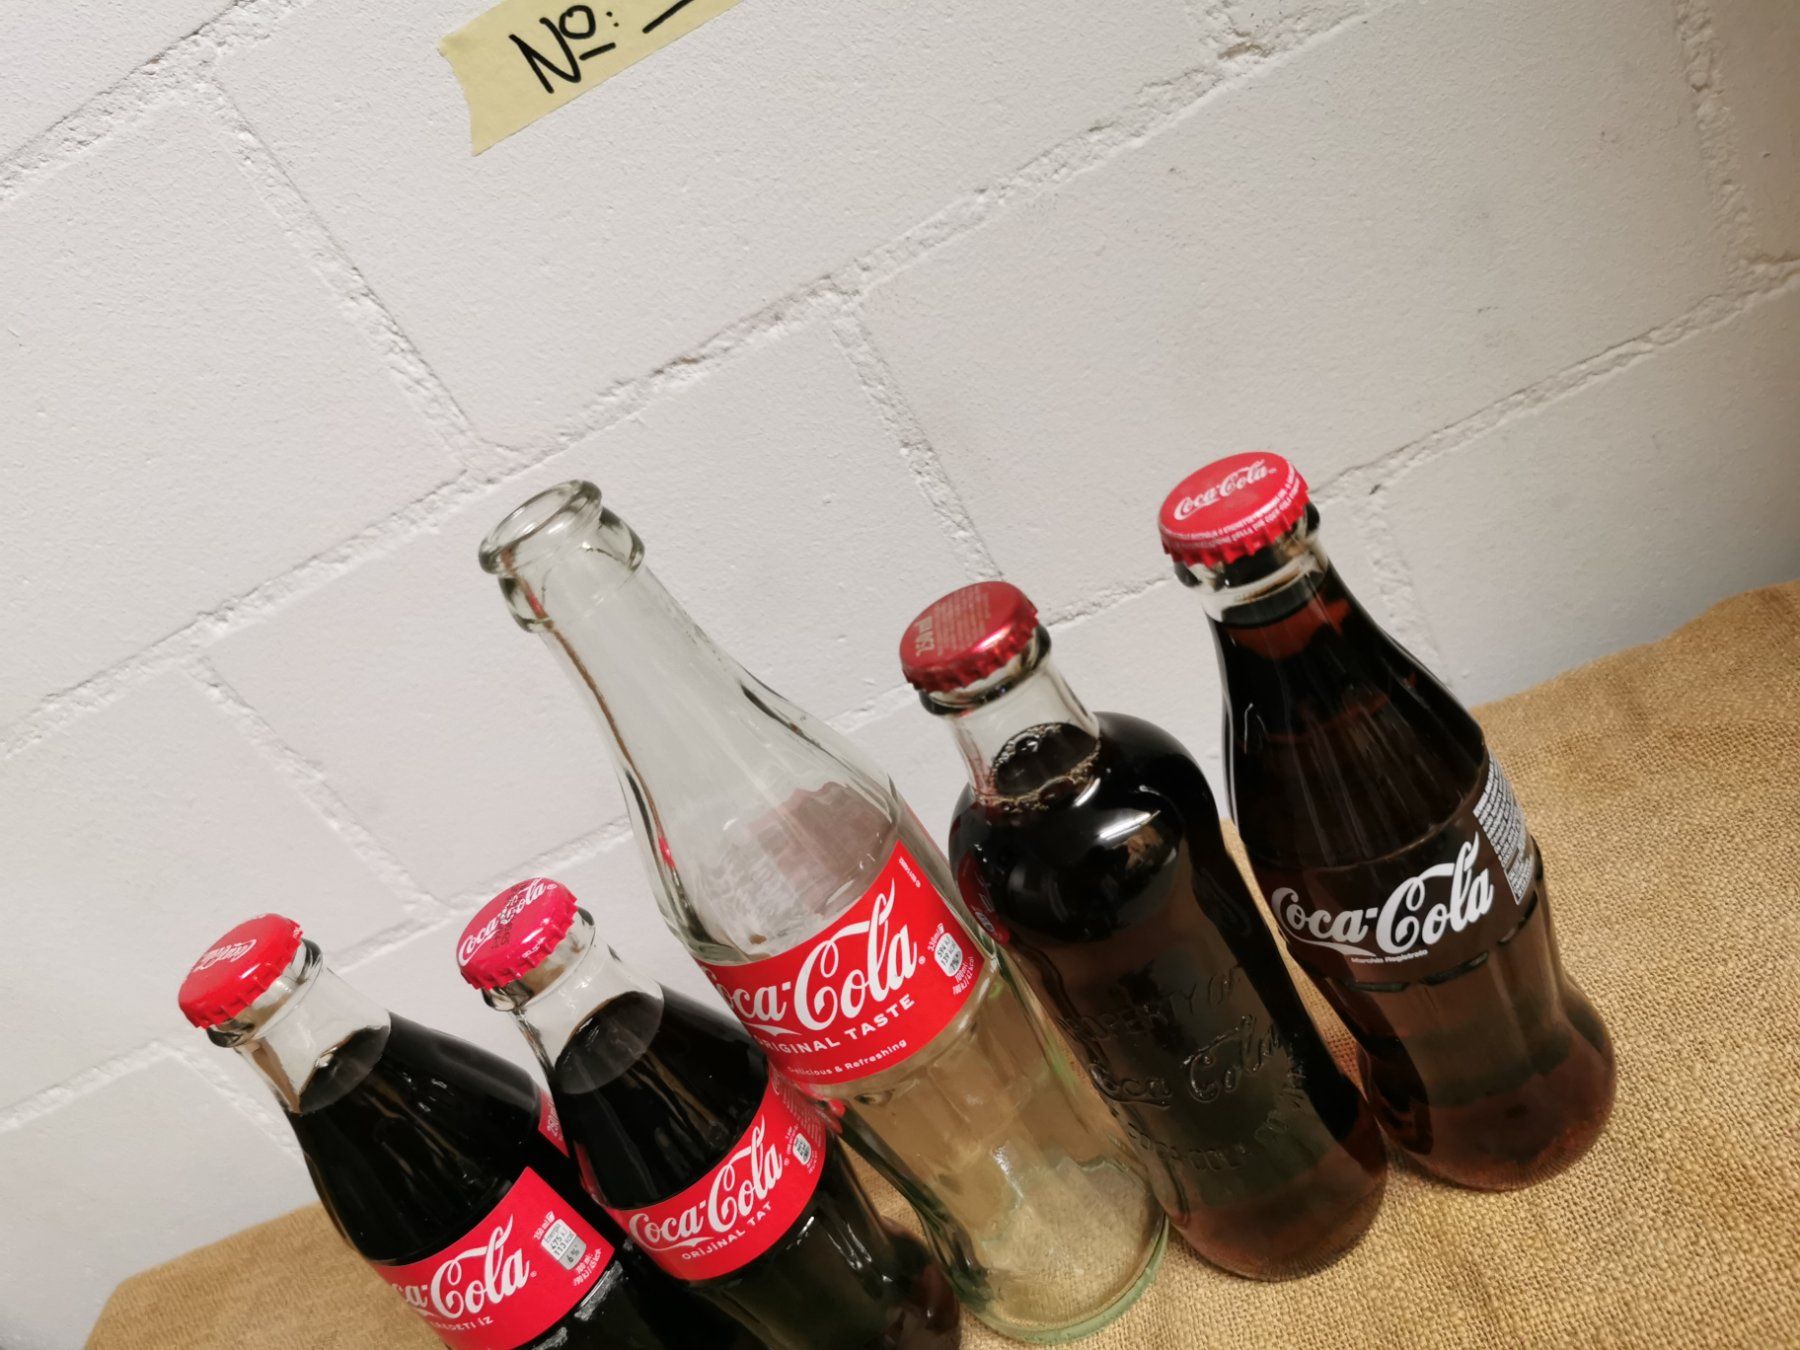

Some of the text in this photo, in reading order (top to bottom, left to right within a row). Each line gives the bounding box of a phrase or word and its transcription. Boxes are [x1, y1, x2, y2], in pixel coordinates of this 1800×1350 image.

[1174, 459, 1268, 521] Coca-Cola
[1271, 832, 1494, 957] Coca-Cola
[844, 993, 916, 1040] TASTE
[845, 1039, 907, 1070] Refreshing
[628, 1114, 783, 1252] Coca-Cola
[747, 1202, 773, 1227] TAT
